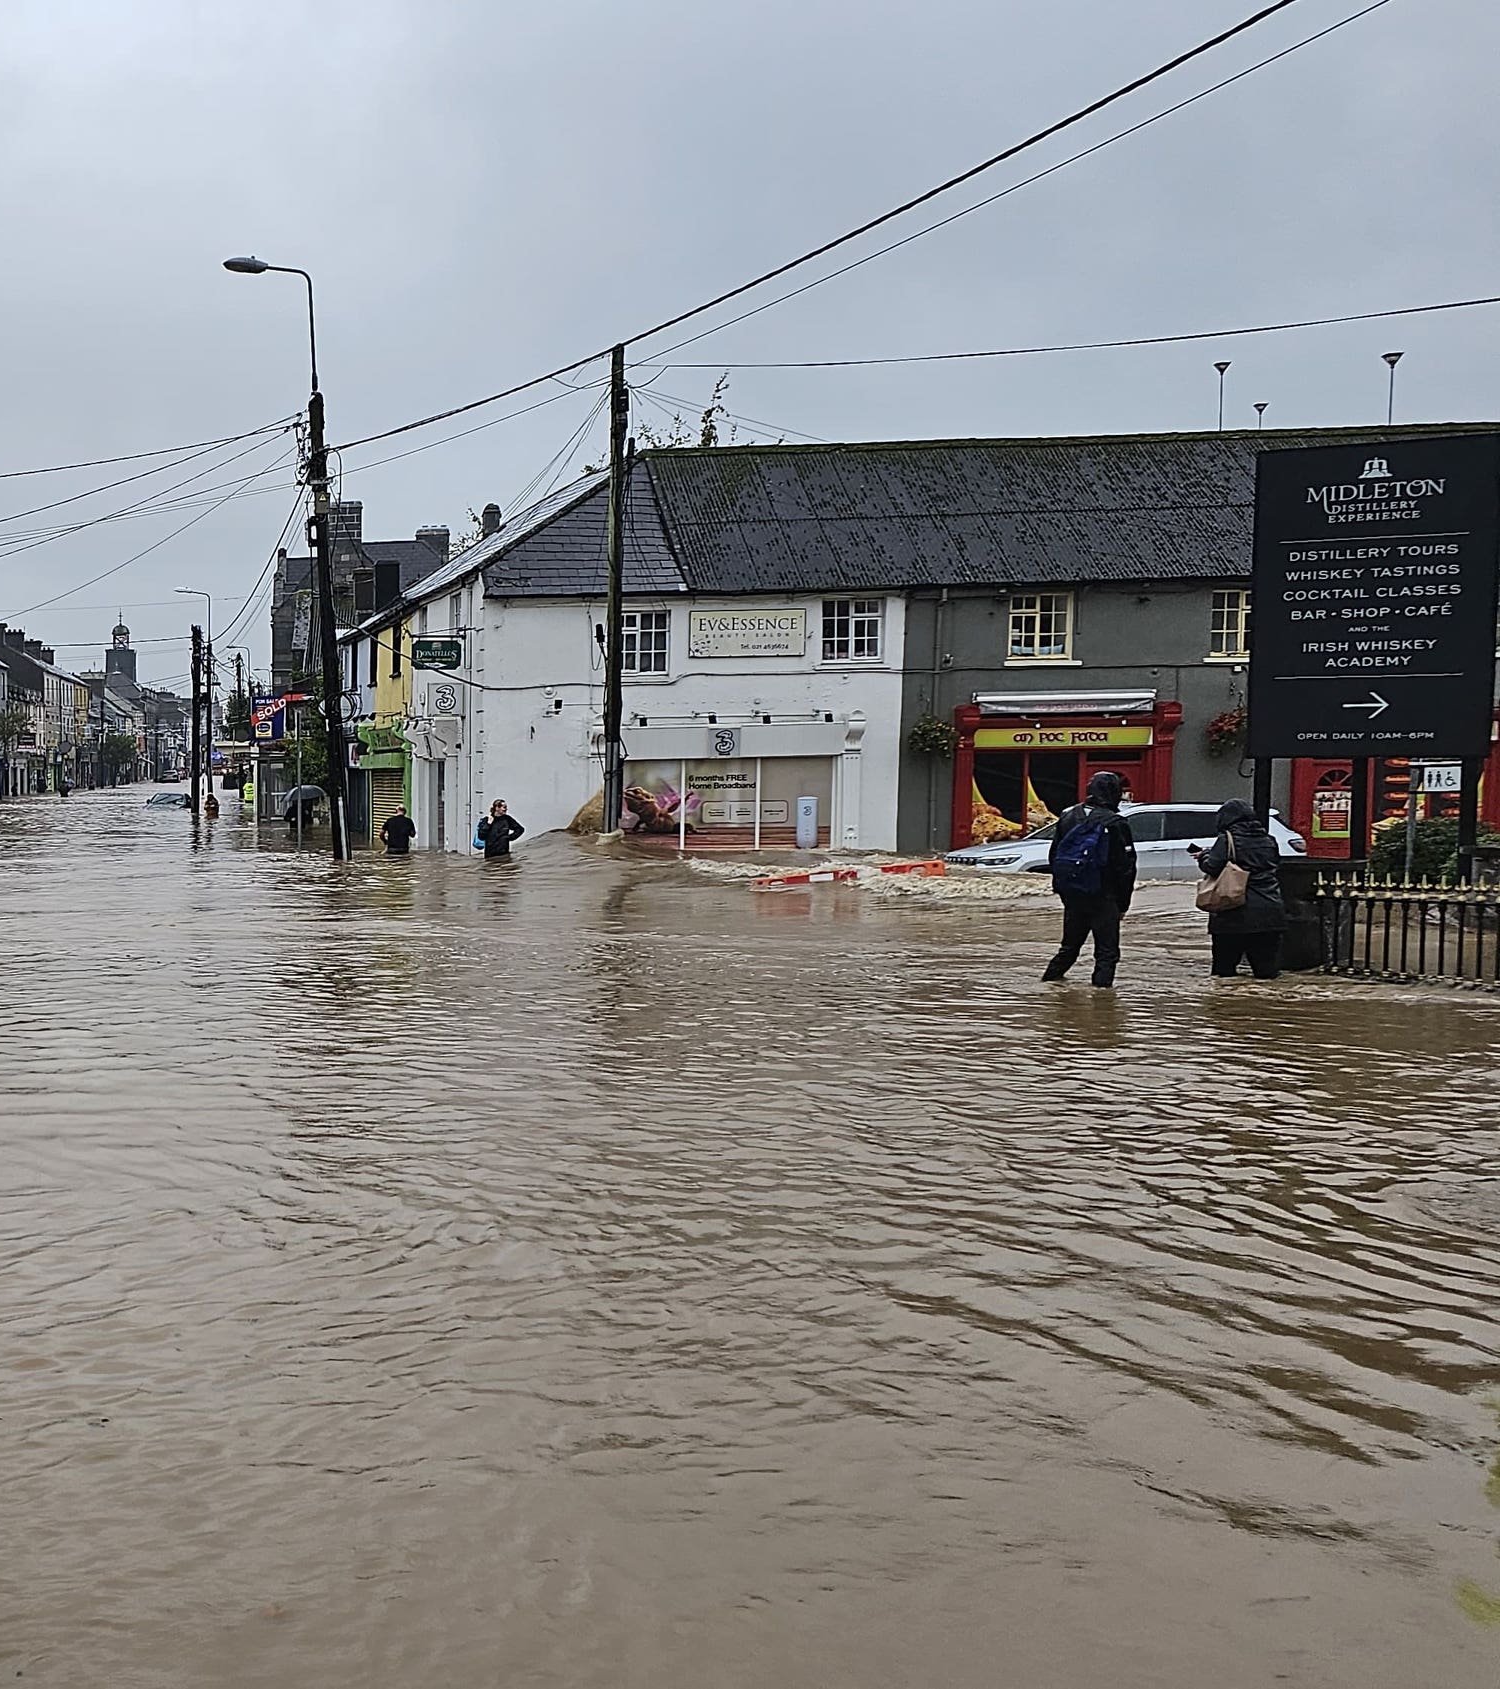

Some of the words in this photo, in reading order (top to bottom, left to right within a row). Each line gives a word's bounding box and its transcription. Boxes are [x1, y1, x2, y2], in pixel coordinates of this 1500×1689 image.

[1305, 479, 1446, 514] MIDLETON
[1332, 500, 1418, 514] DISTILLERY
[1328, 510, 1421, 524] EXPERIENCE
[1289, 547, 1391, 562] DISTILLERY
[1397, 544, 1459, 556] TOURS
[1285, 568, 1366, 581] WHISKEY
[1370, 564, 1461, 578] TASTINGS
[1283, 588, 1370, 601] COCKTAIL
[1375, 584, 1462, 597] CLASSES
[1291, 609, 1327, 620] BAR
[1340, 607, 1391, 619] SHOP
[1404, 601, 1453, 616] CAFÉ
[1302, 642, 1349, 653] IRISH
[1355, 639, 1438, 651] WHISKEY
[1325, 656, 1412, 668] ACADEMY
[257, 698, 286, 720] SOLD
[715, 729, 734, 755] 3
[688, 782, 712, 790] Home
[713, 782, 756, 790] Broadband
[726, 774, 748, 782] FREE
